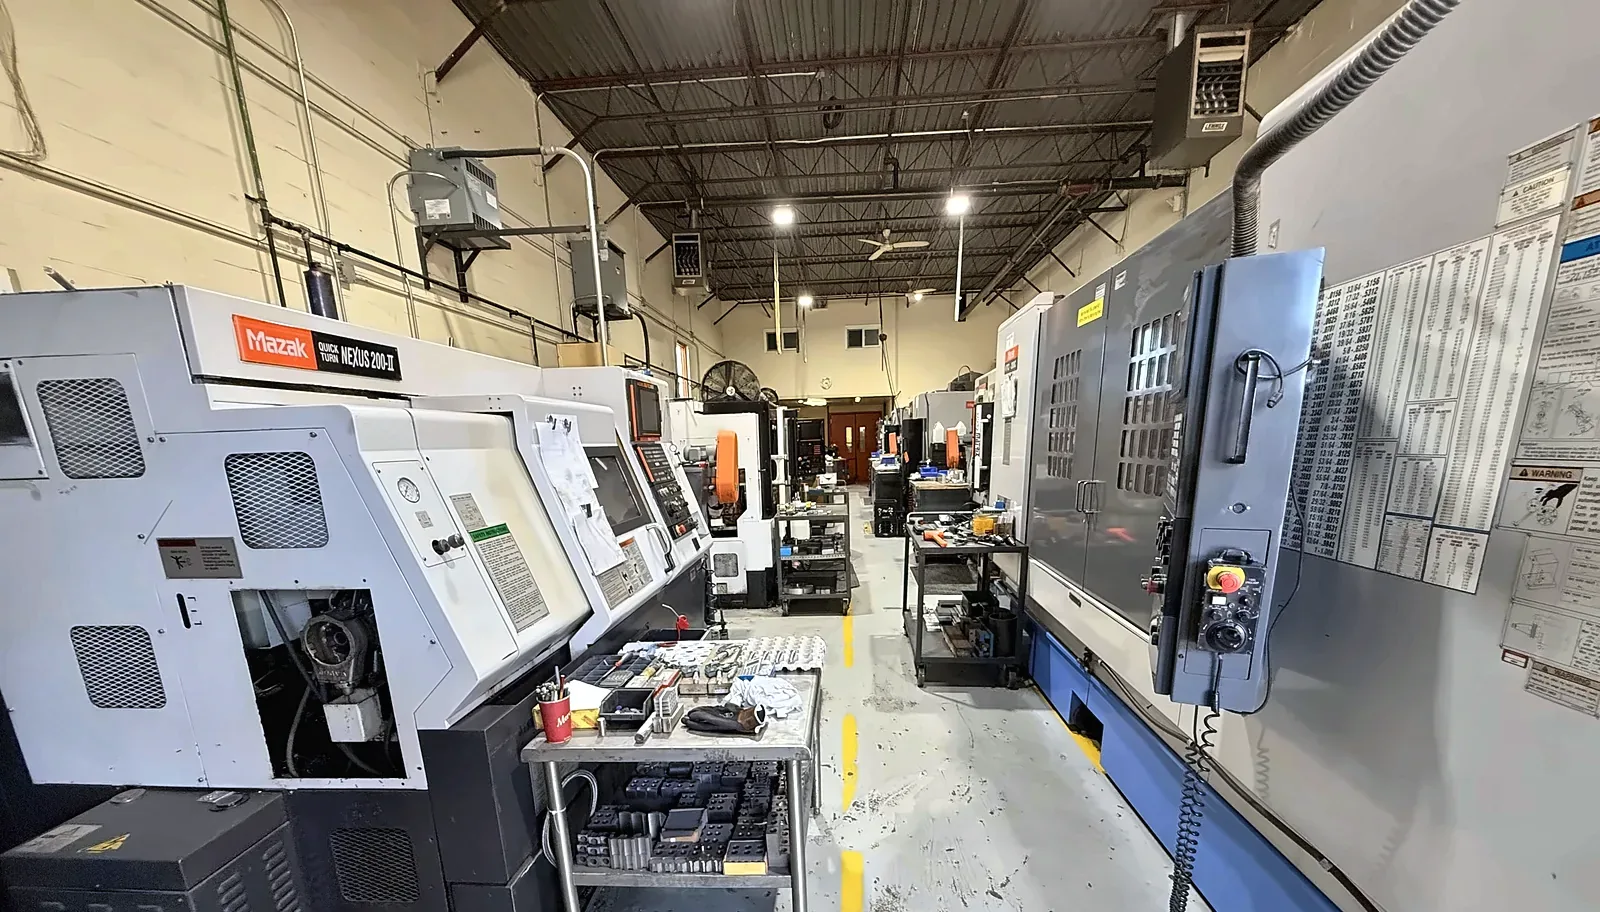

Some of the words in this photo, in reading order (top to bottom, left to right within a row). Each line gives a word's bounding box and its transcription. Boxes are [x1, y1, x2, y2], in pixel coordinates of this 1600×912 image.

[1522, 177, 1554, 194] CAUTION
[246, 328, 308, 358] Mazak
[318, 342, 340, 354] QUICK
[320, 352, 339, 363] TURN
[340, 345, 370, 368] NEXUS
[1532, 469, 1573, 479] WARNING
